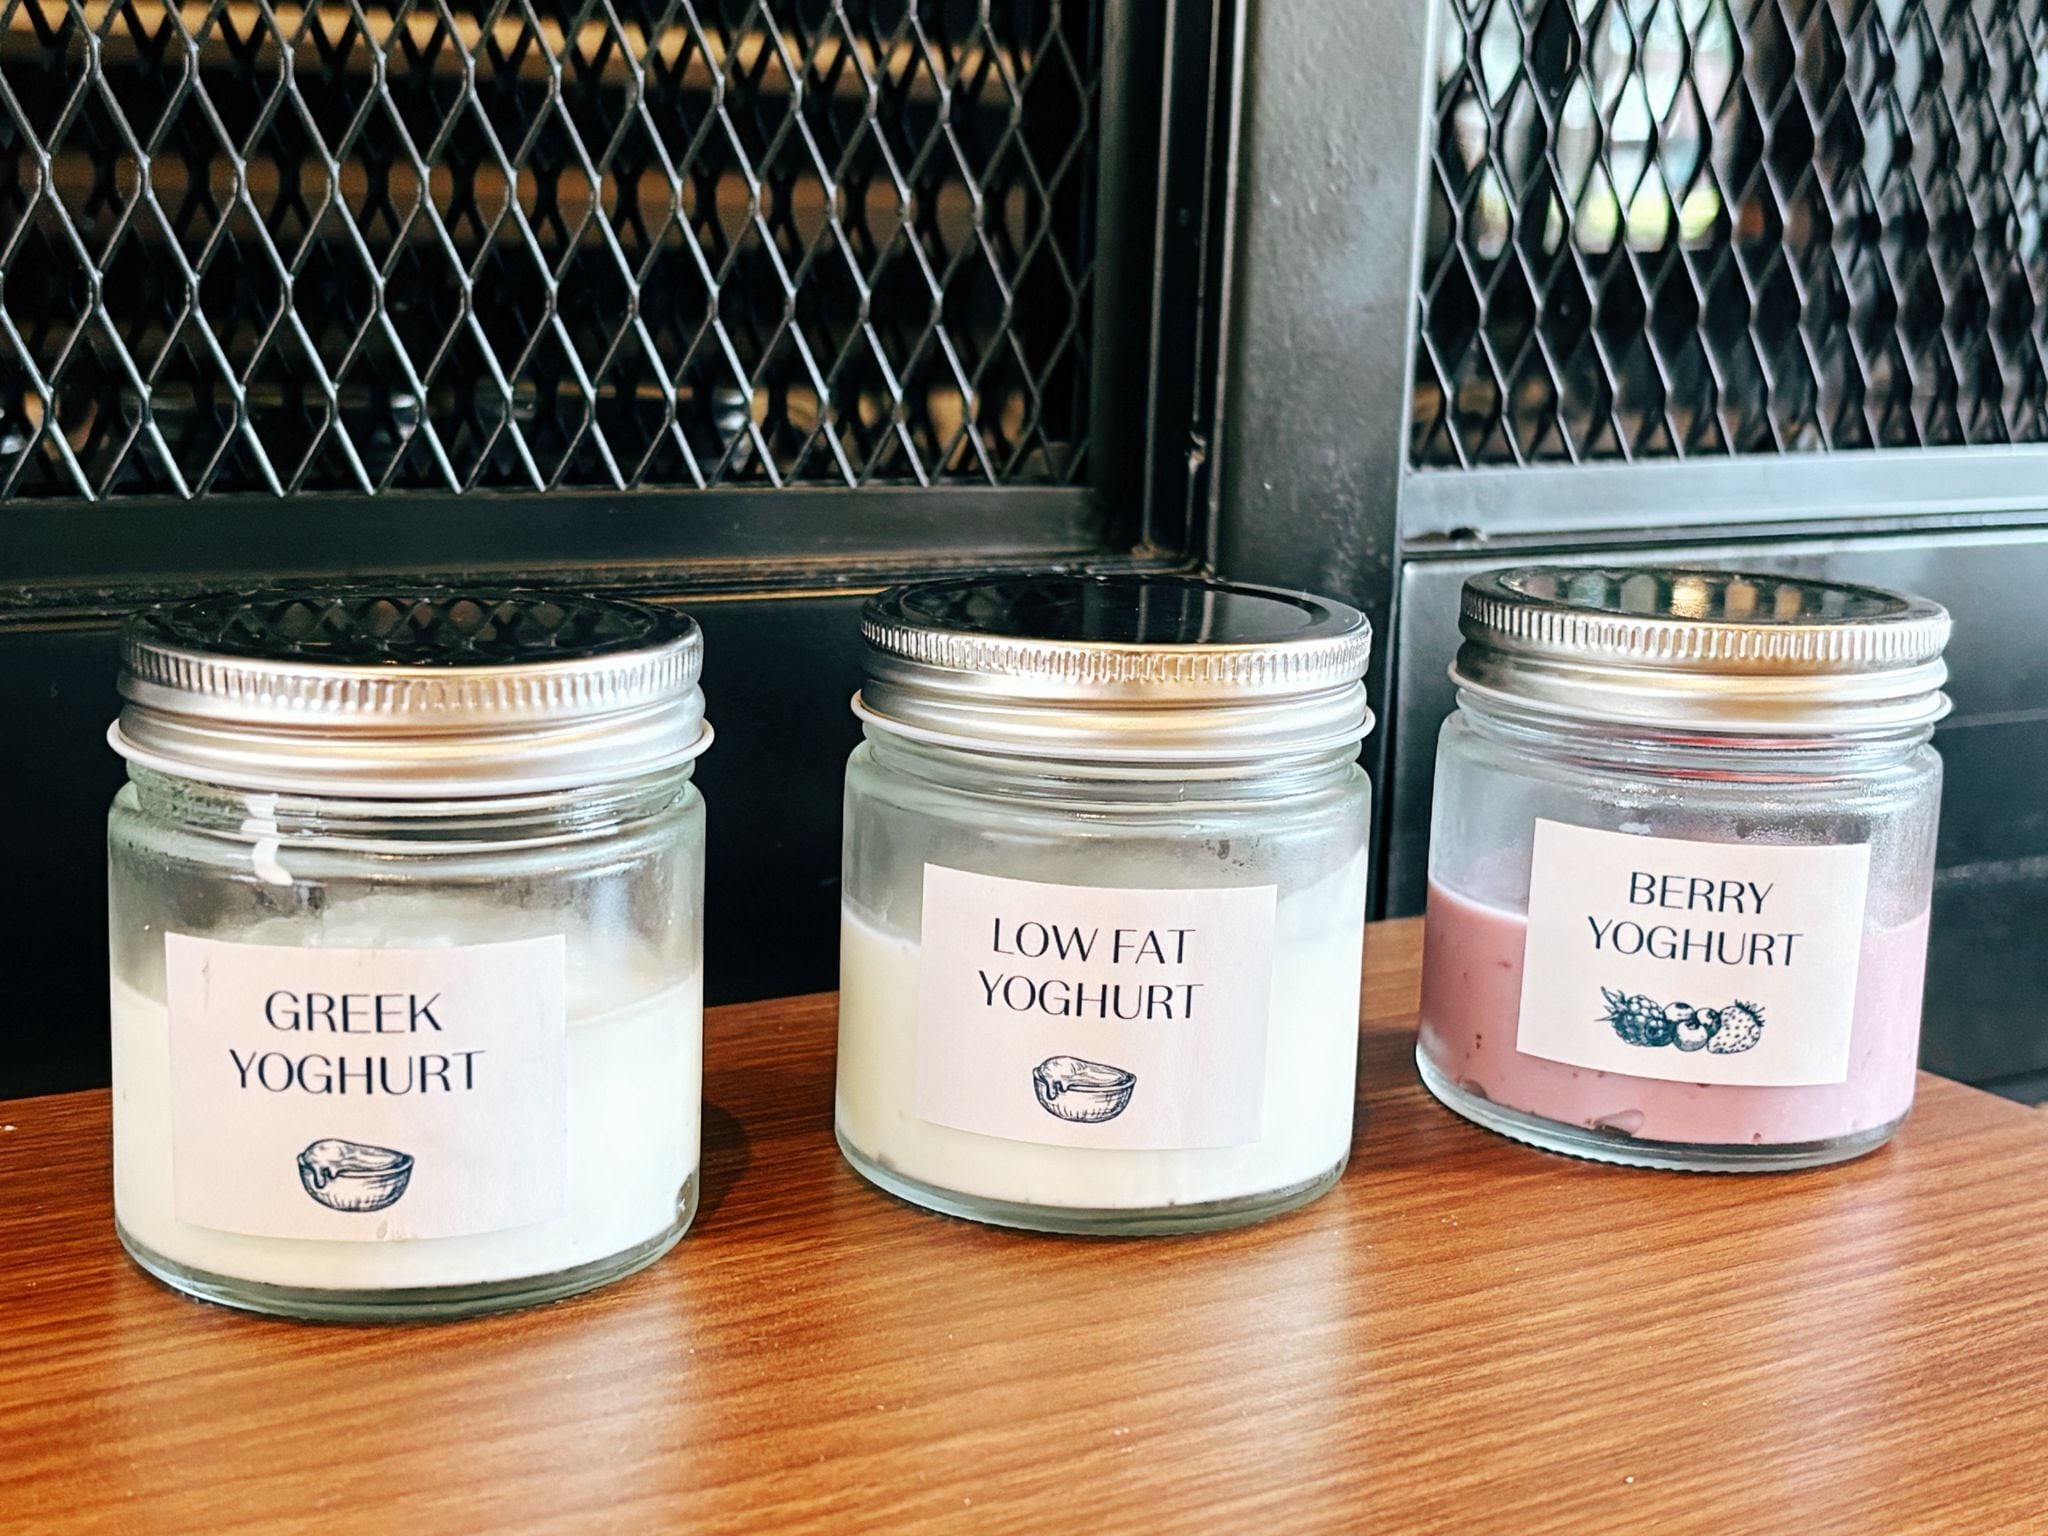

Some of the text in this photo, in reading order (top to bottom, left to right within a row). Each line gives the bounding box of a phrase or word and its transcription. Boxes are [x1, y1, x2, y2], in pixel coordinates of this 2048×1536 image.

[1628, 871, 1774, 914] BERRY
[993, 917, 1197, 965] LOW FAT
[1587, 915, 1804, 966] YOGHURT
[265, 990, 443, 1034] GREEK
[978, 969, 1205, 1020] YOGHURT
[228, 1048, 487, 1095] YOGHURT
